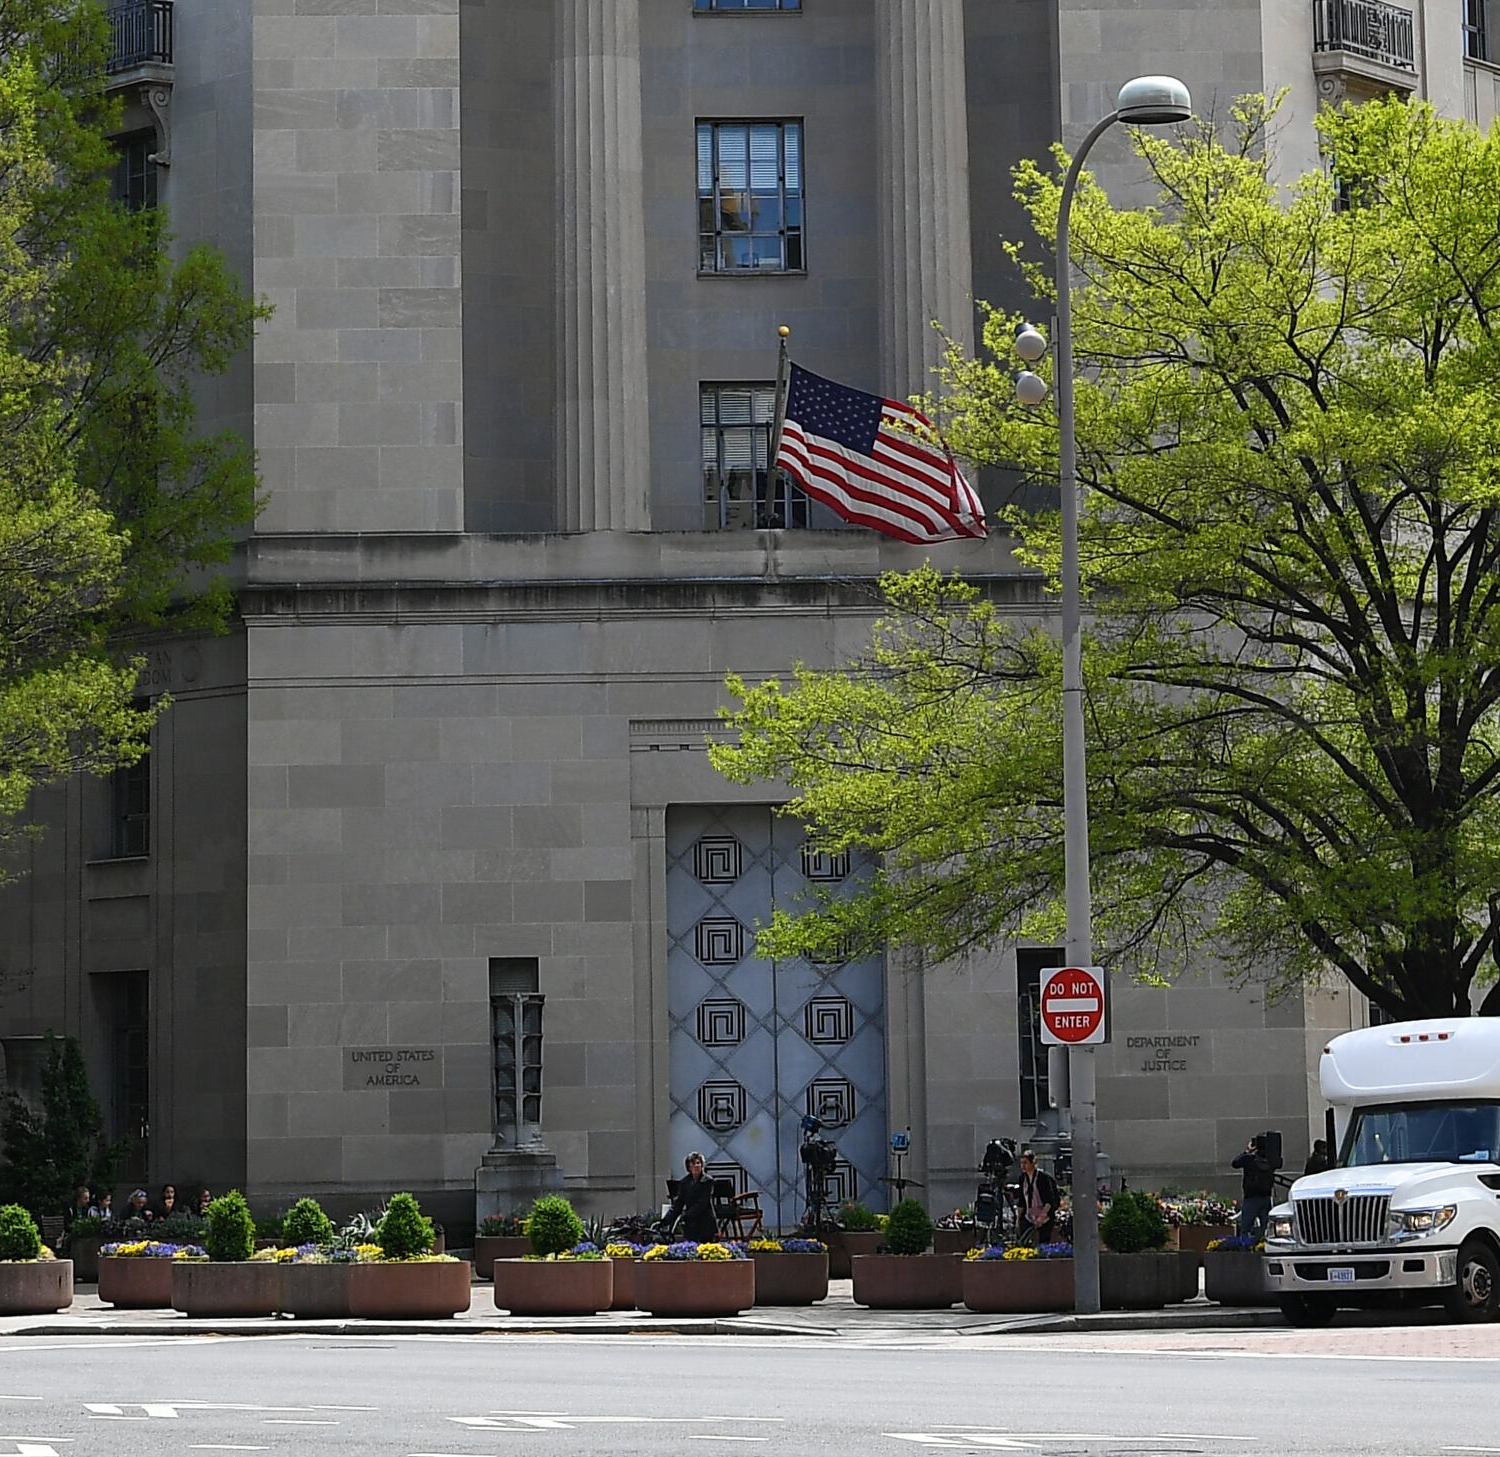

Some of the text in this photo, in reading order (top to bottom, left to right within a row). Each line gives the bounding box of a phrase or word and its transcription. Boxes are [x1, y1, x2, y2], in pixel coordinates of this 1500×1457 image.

[1050, 982, 1094, 995] DO NOT
[1055, 1016, 1090, 1028] ENTER
[1127, 1036, 1200, 1048] DEPARTMENT
[352, 1050, 434, 1062] UNITED STATES
[1156, 1049, 1171, 1059] OF
[386, 1063, 401, 1073] OF
[1141, 1060, 1186, 1071] JUSTICE
[366, 1075, 420, 1085] AMERICA
